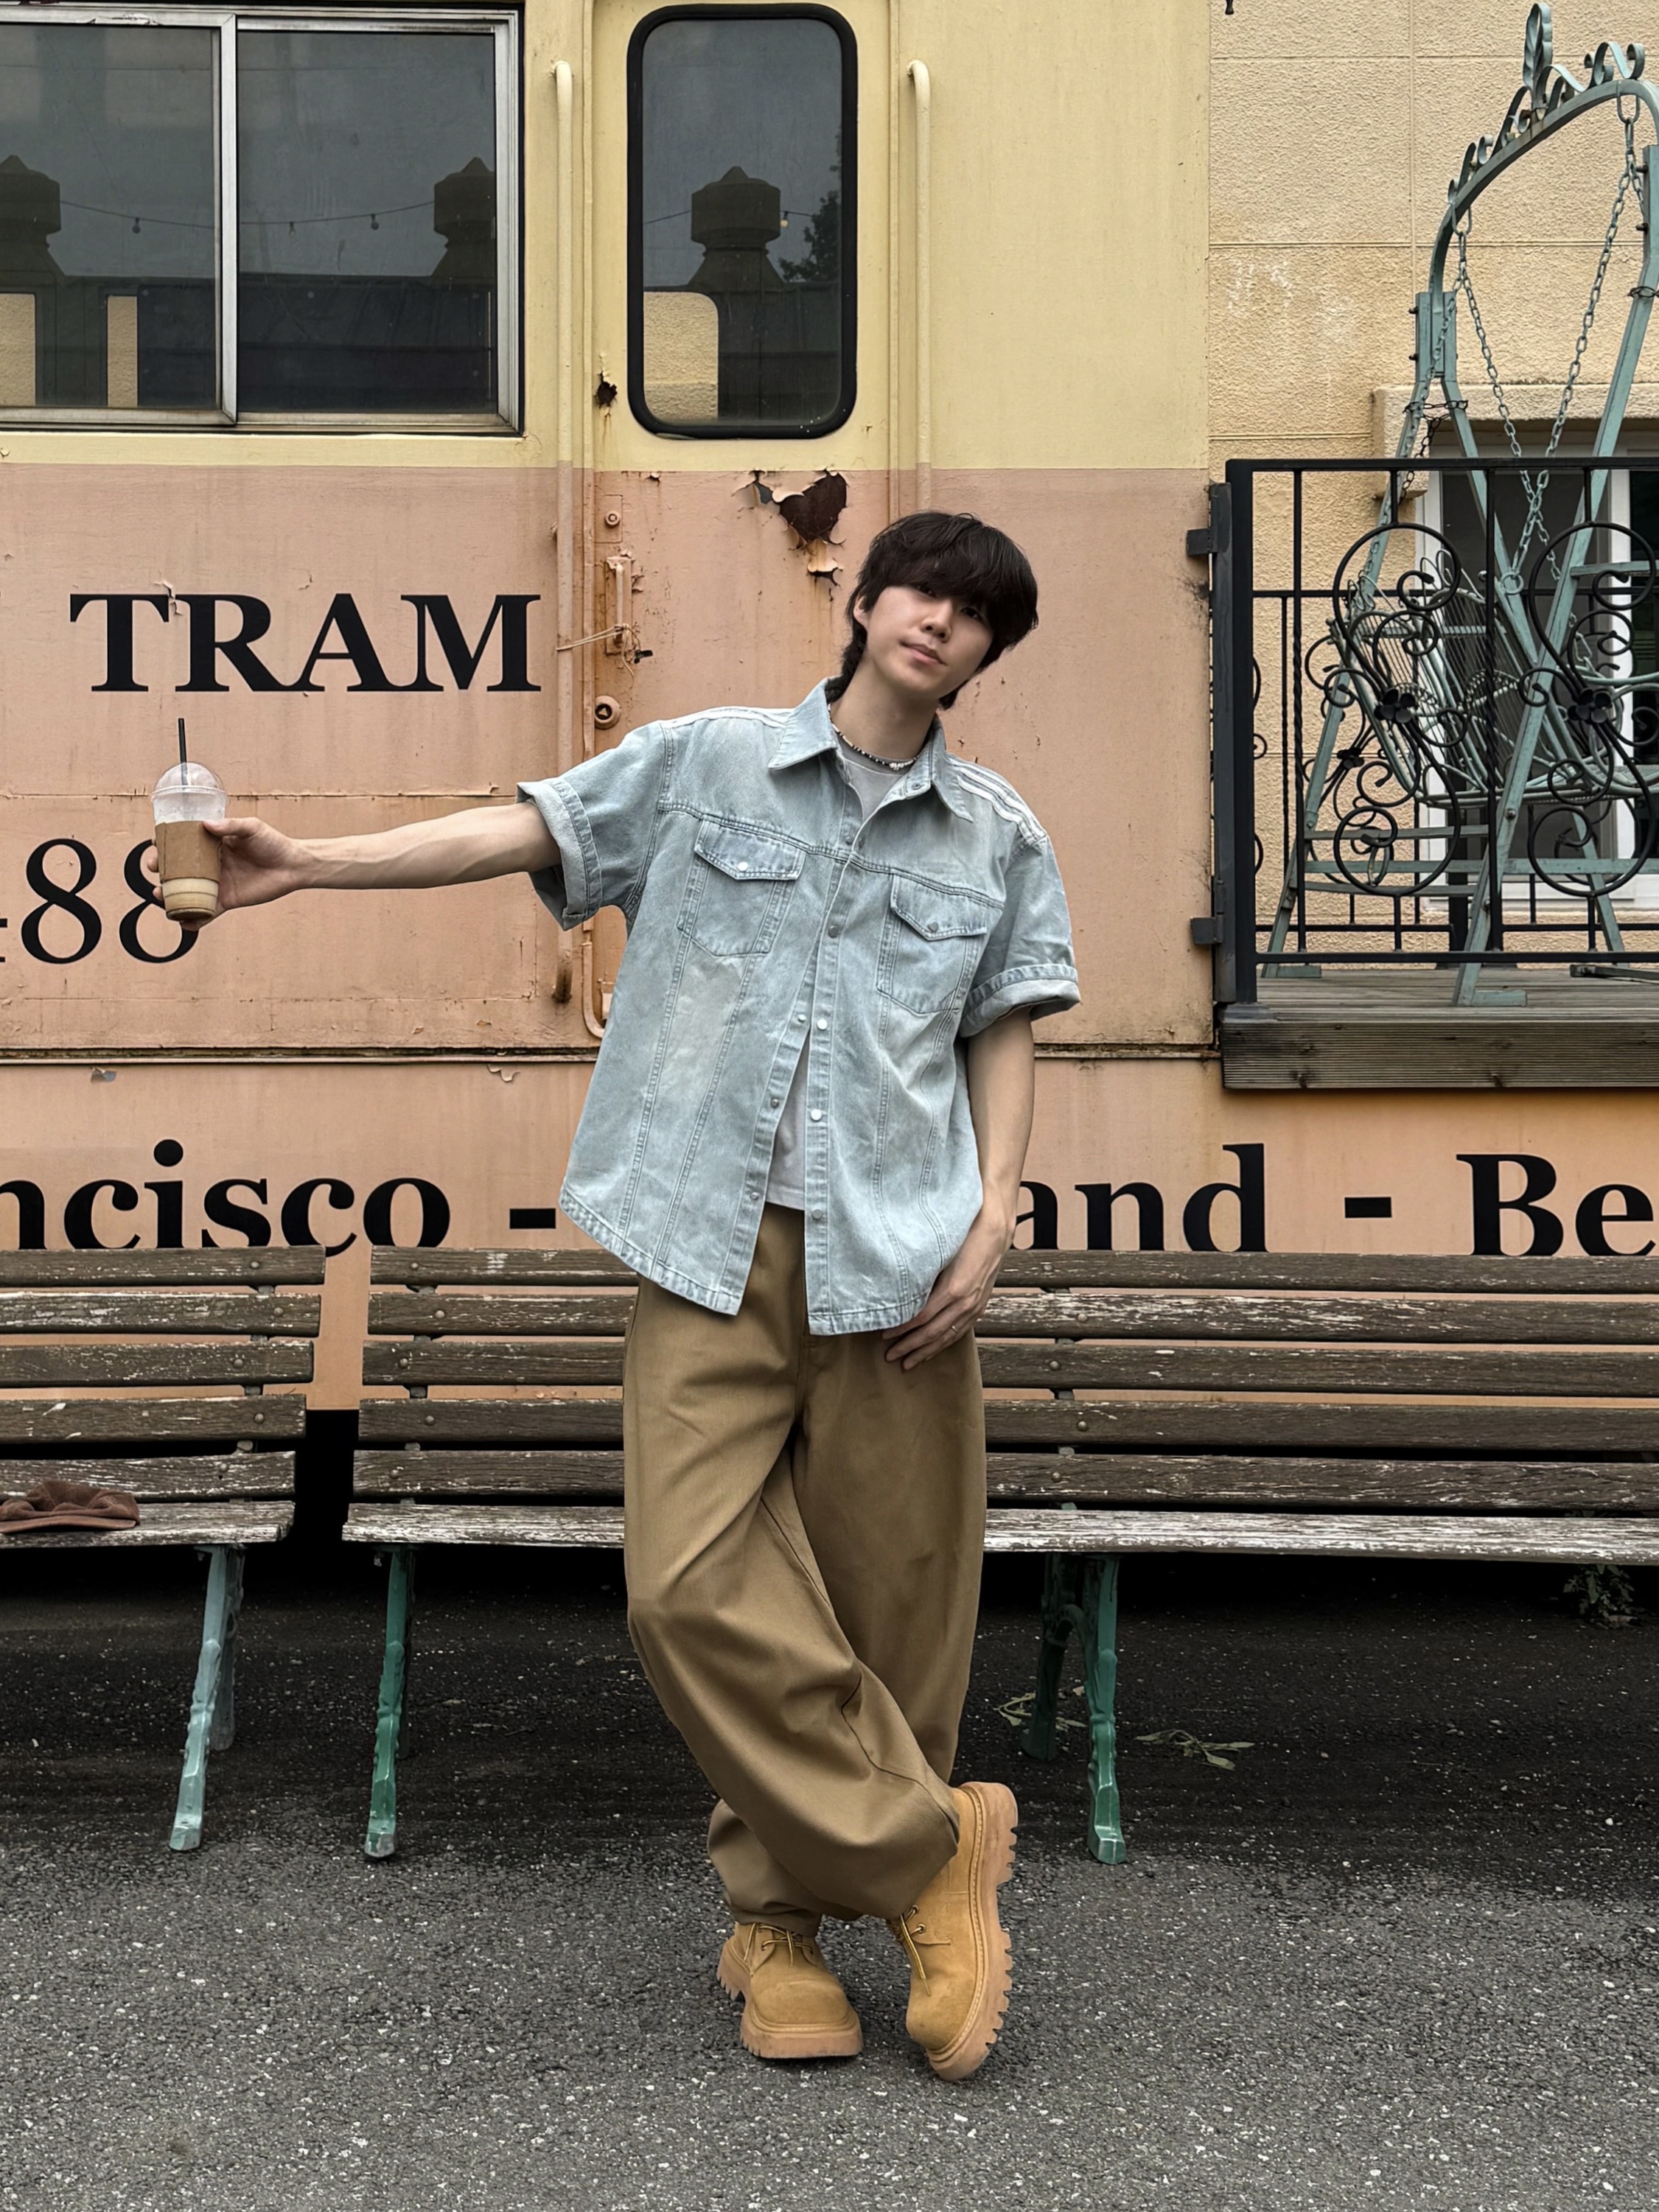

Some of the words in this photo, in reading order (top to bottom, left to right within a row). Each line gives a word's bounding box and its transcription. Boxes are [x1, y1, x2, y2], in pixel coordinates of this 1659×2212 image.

[70, 594, 541, 692] TRAM
[0, 839, 199, 964] 88
[1456, 1154, 1656, 1256] Be
